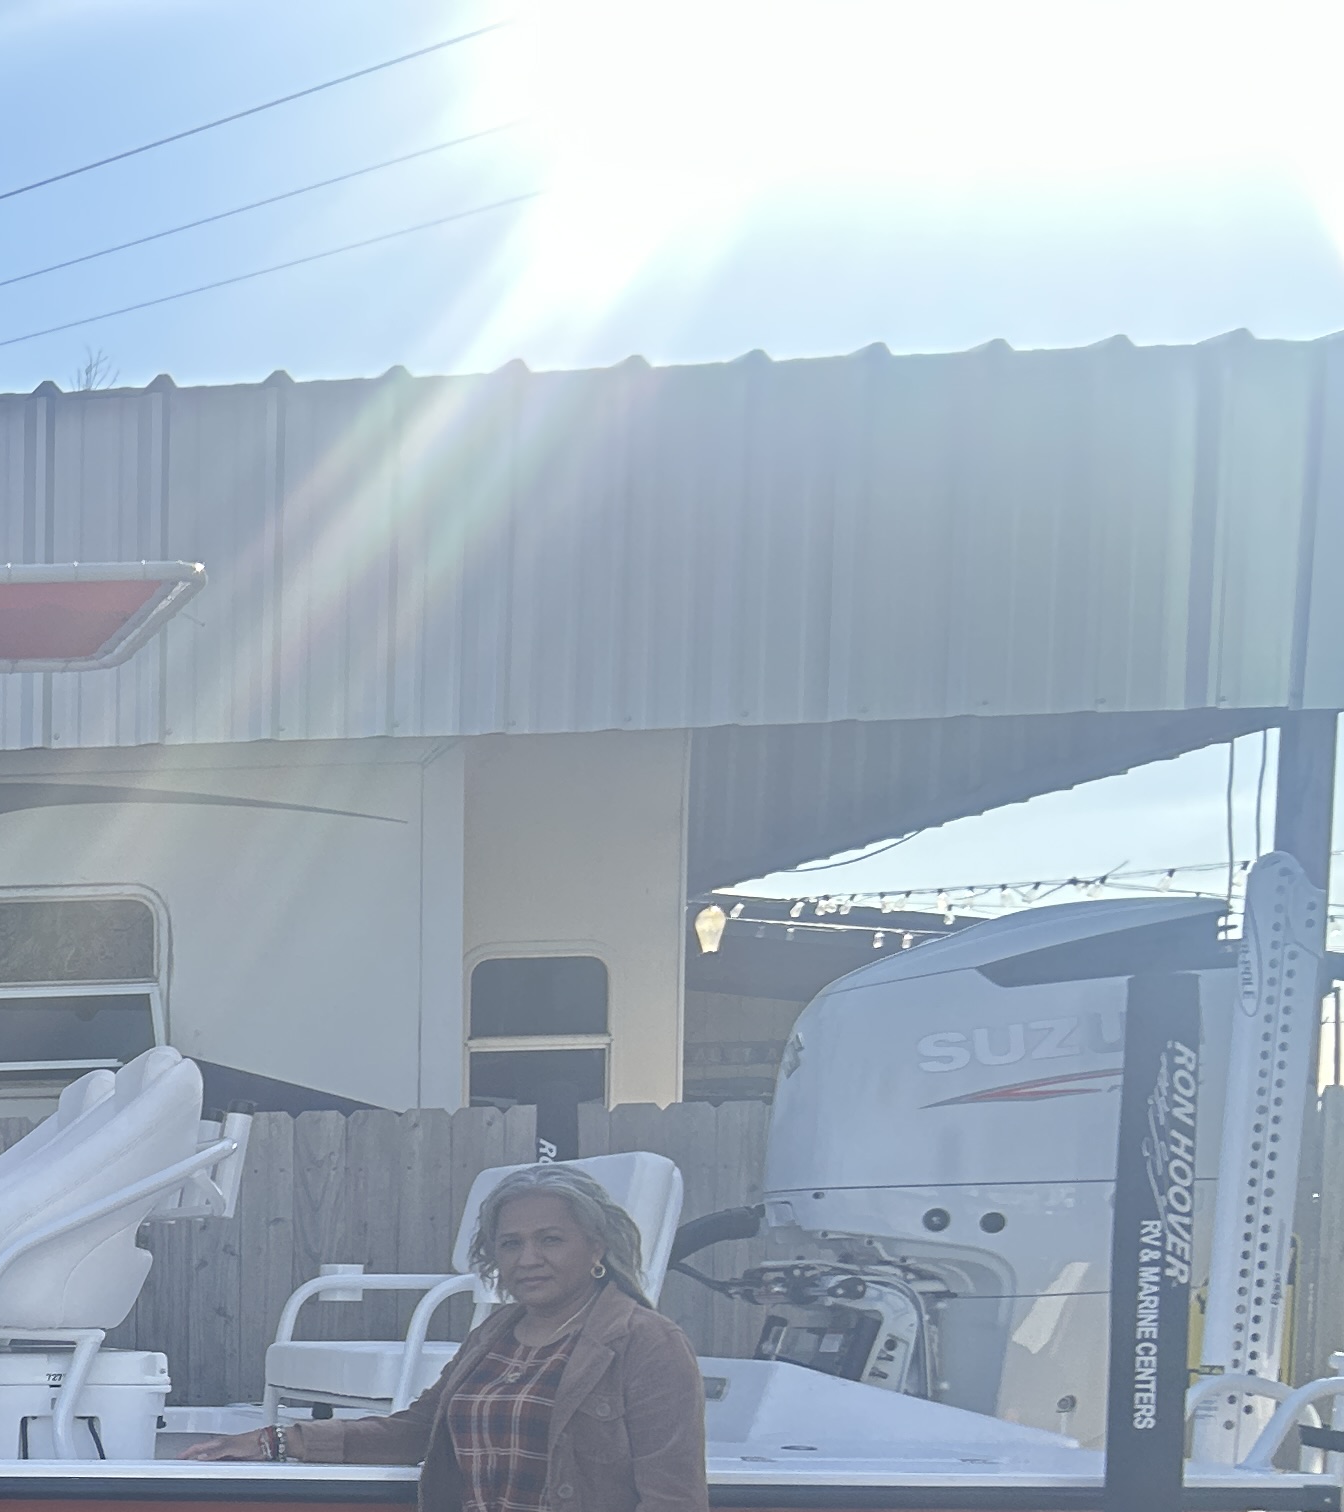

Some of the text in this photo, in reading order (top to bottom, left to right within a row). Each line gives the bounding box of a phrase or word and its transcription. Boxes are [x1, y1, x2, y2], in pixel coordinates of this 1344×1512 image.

[916, 1009, 1125, 1073] SUZU
[1164, 1040, 1197, 1286] RON HOOVER
[1132, 1219, 1162, 1430] RV & MARINE CENTERS
